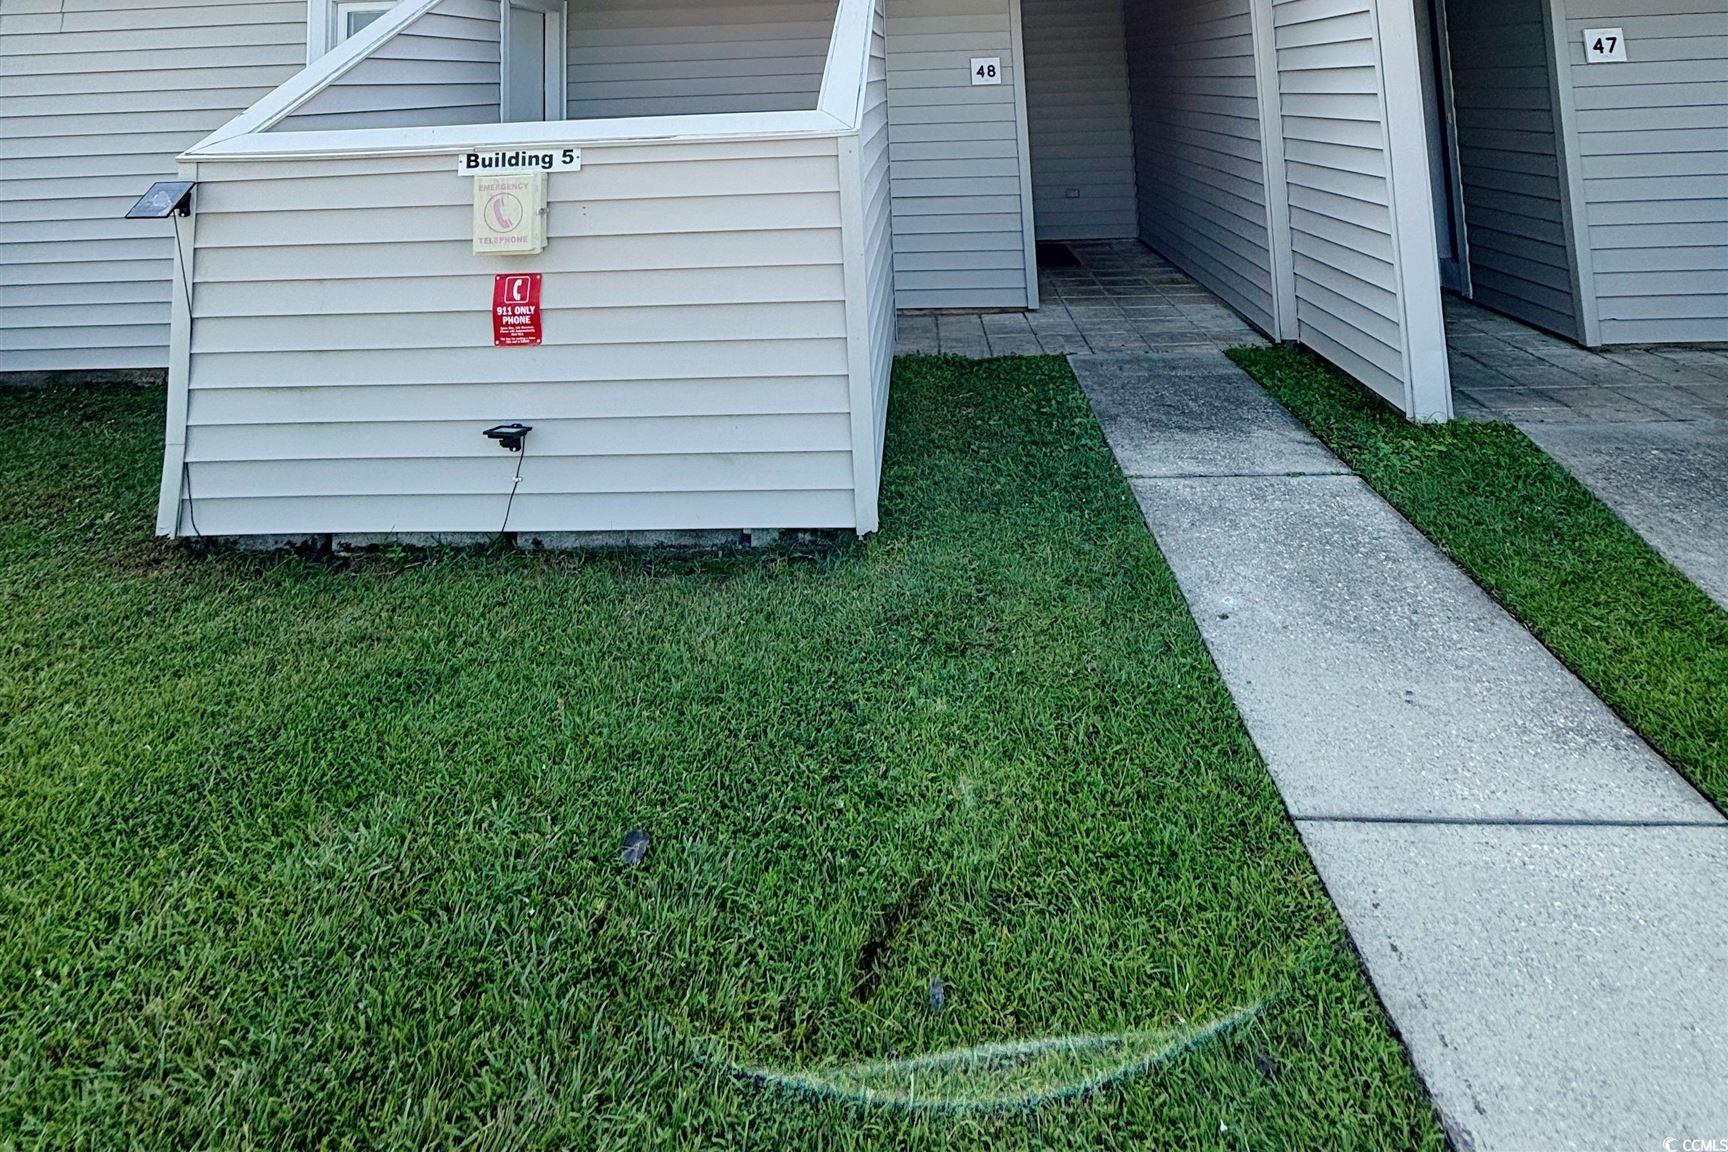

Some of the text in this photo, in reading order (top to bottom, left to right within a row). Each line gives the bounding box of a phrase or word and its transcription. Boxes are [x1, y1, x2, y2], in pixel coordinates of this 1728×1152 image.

[1592, 36, 1617, 54] 47
[976, 64, 996, 78] 48
[466, 149, 574, 169] Building 5
[479, 183, 528, 192] EMERGENCY
[479, 236, 528, 245] TELEPHONE
[497, 306, 535, 315] 911 ONLY
[503, 316, 531, 324] PHONE
